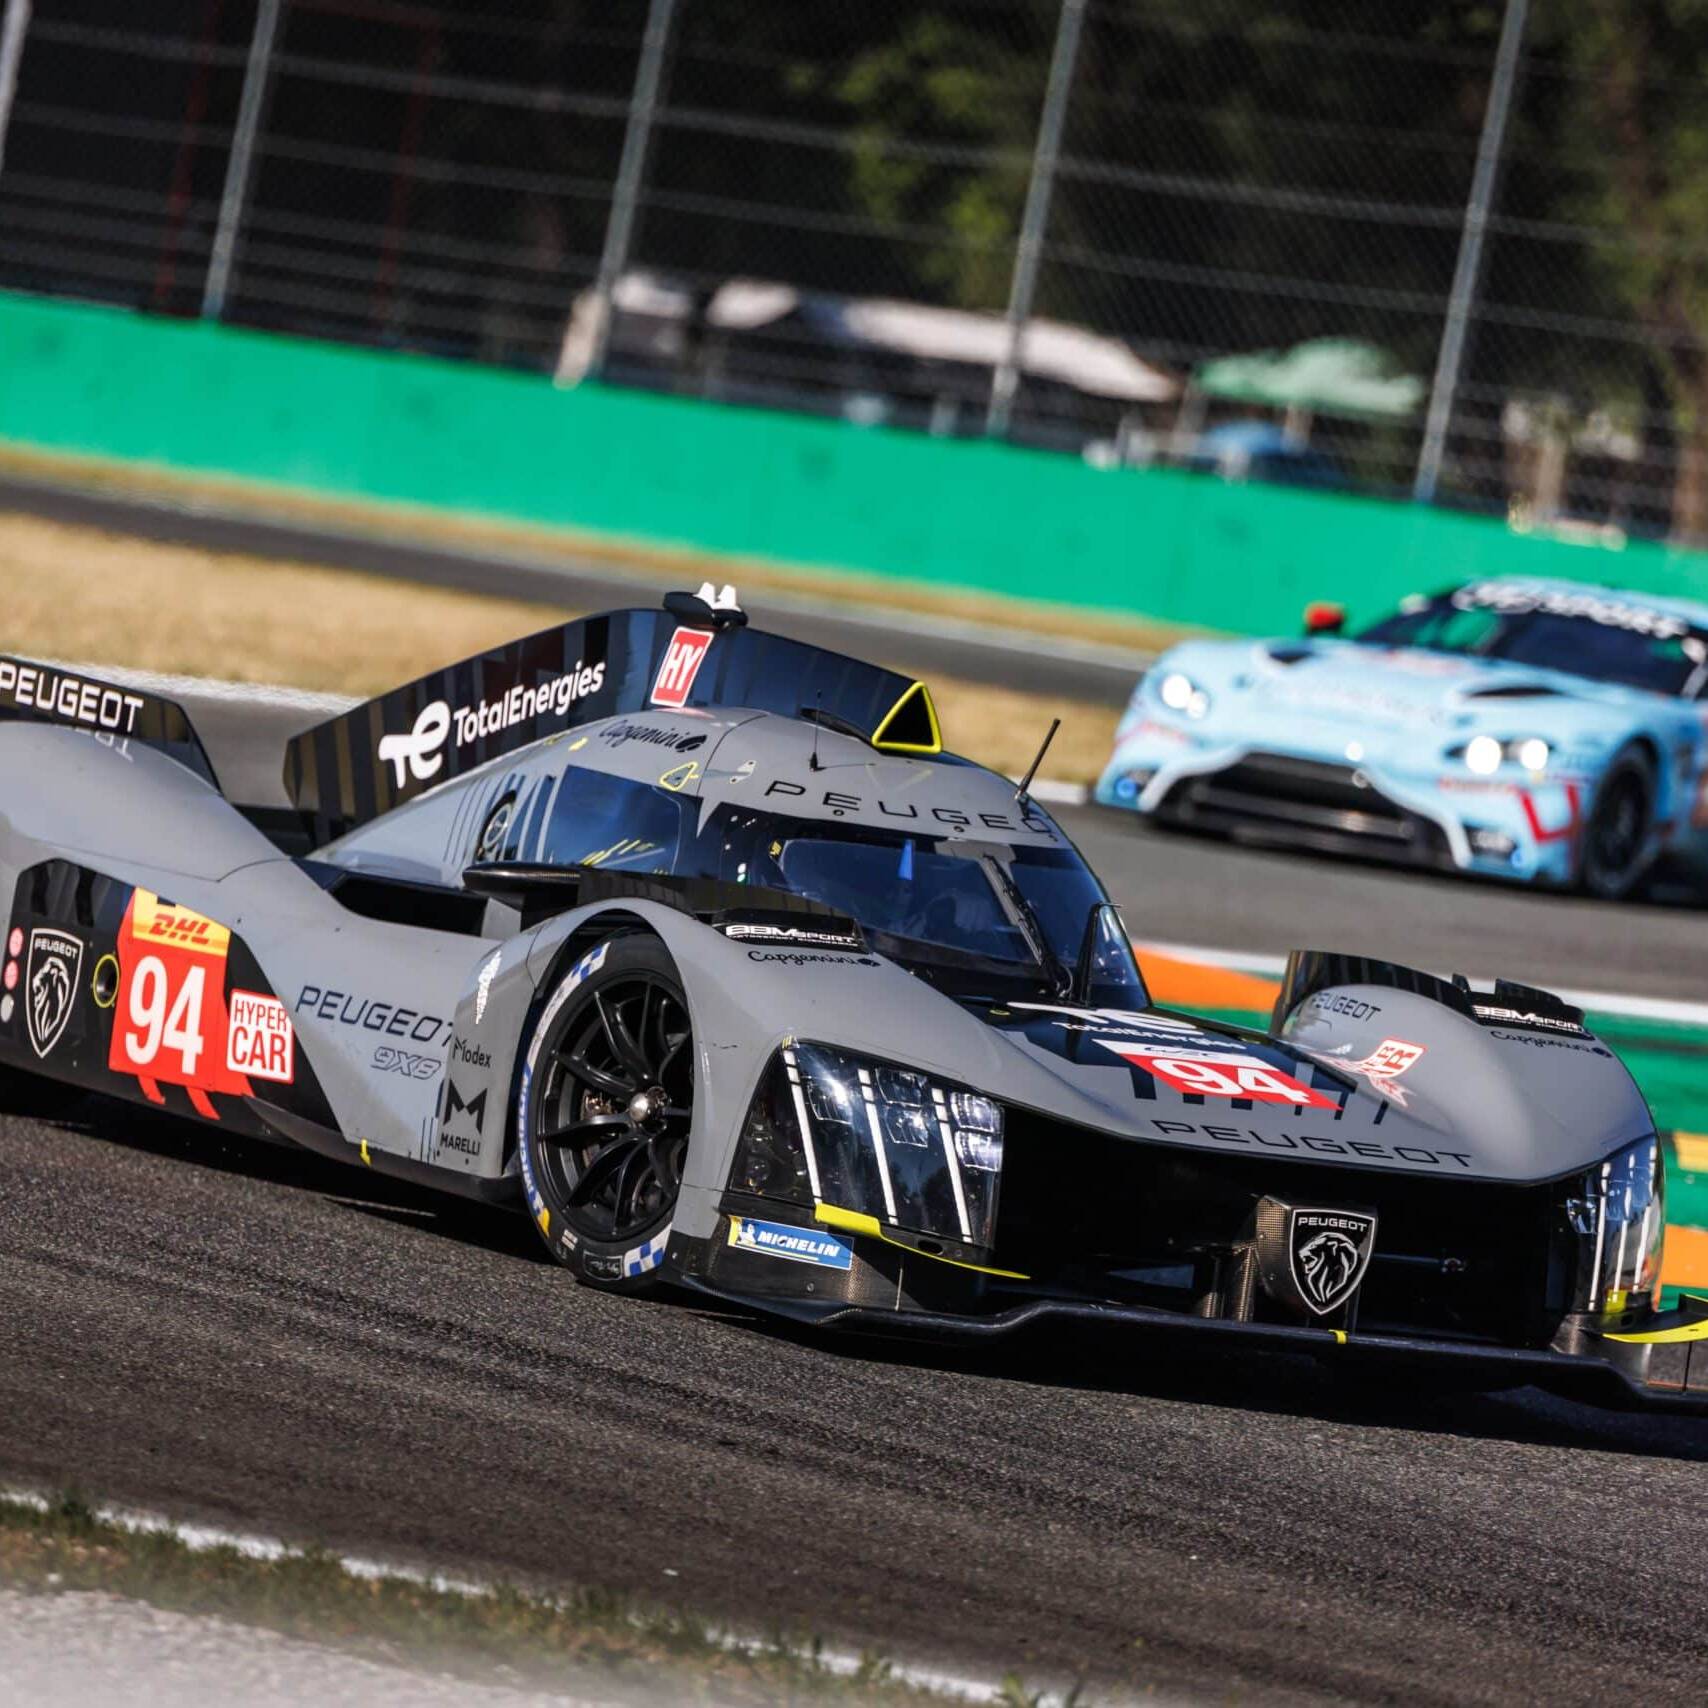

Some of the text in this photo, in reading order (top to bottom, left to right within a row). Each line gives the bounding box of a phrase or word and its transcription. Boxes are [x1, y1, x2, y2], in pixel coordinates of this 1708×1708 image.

[658, 642, 704, 692] HY
[0, 662, 144, 733] PEUGEOT
[453, 660, 606, 747] TotalEnergies
[765, 780, 1051, 834] PEUGEO
[34, 937, 78, 959] PEUGEOT
[149, 913, 210, 945] DHL
[125, 955, 206, 1076] 94
[233, 999, 288, 1032] HYPER
[231, 1026, 288, 1074] CAR
[371, 1046, 442, 1081] 9X8
[1151, 1058, 1312, 1104] 94
[440, 1132, 481, 1156] MARELLI
[1151, 1120, 1472, 1168] PEUGEOT
[757, 1229, 840, 1258] MICHELIN
[1297, 1216, 1368, 1233] PEUGEOT
